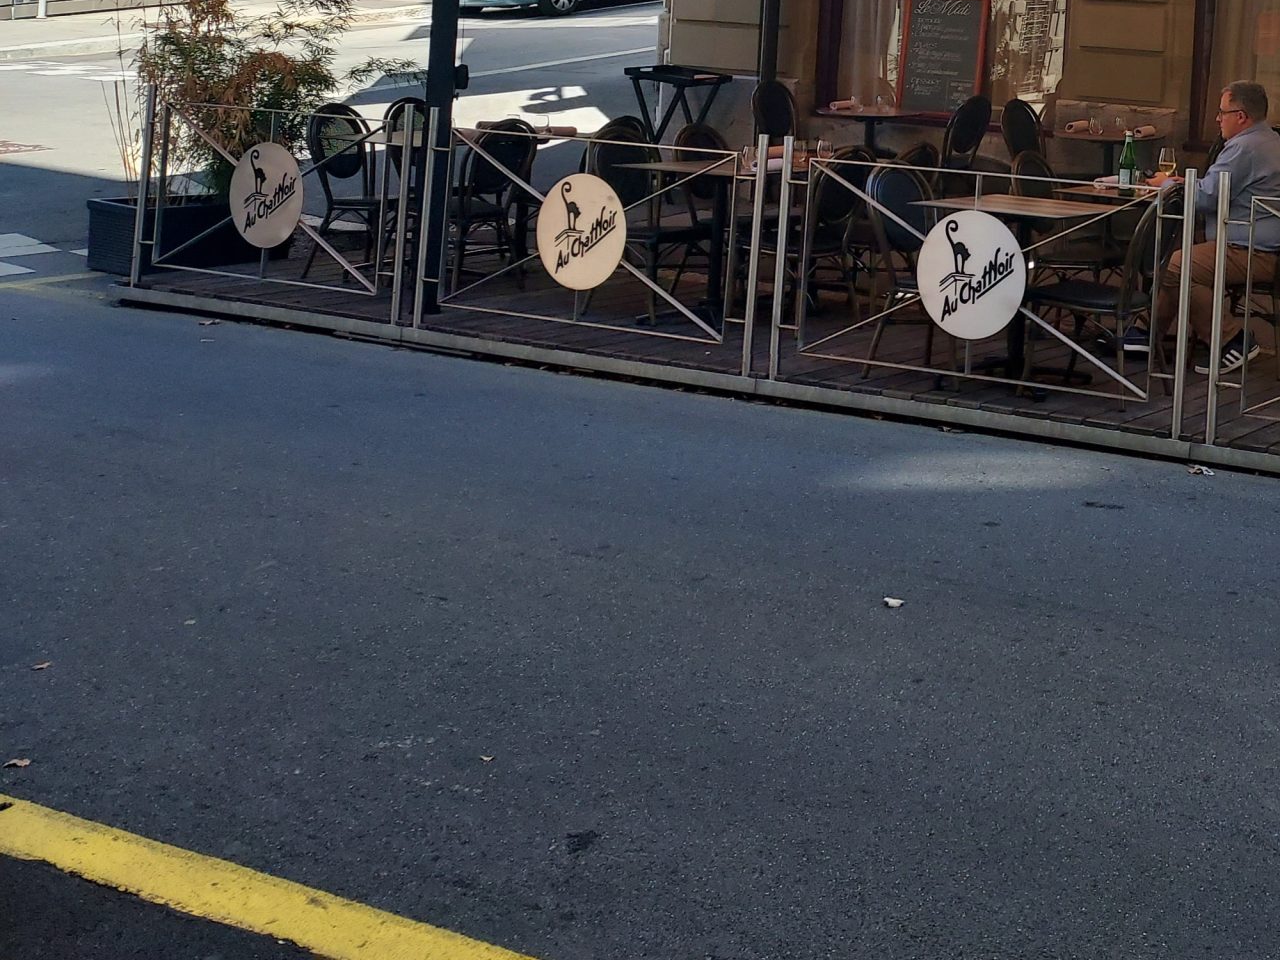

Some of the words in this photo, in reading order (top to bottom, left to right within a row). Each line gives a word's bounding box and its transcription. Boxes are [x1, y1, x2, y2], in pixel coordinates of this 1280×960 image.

[913, 0, 933, 14] Le
[243, 211, 257, 233] Au
[555, 250, 569, 274] Au
[940, 295, 958, 322] Au
